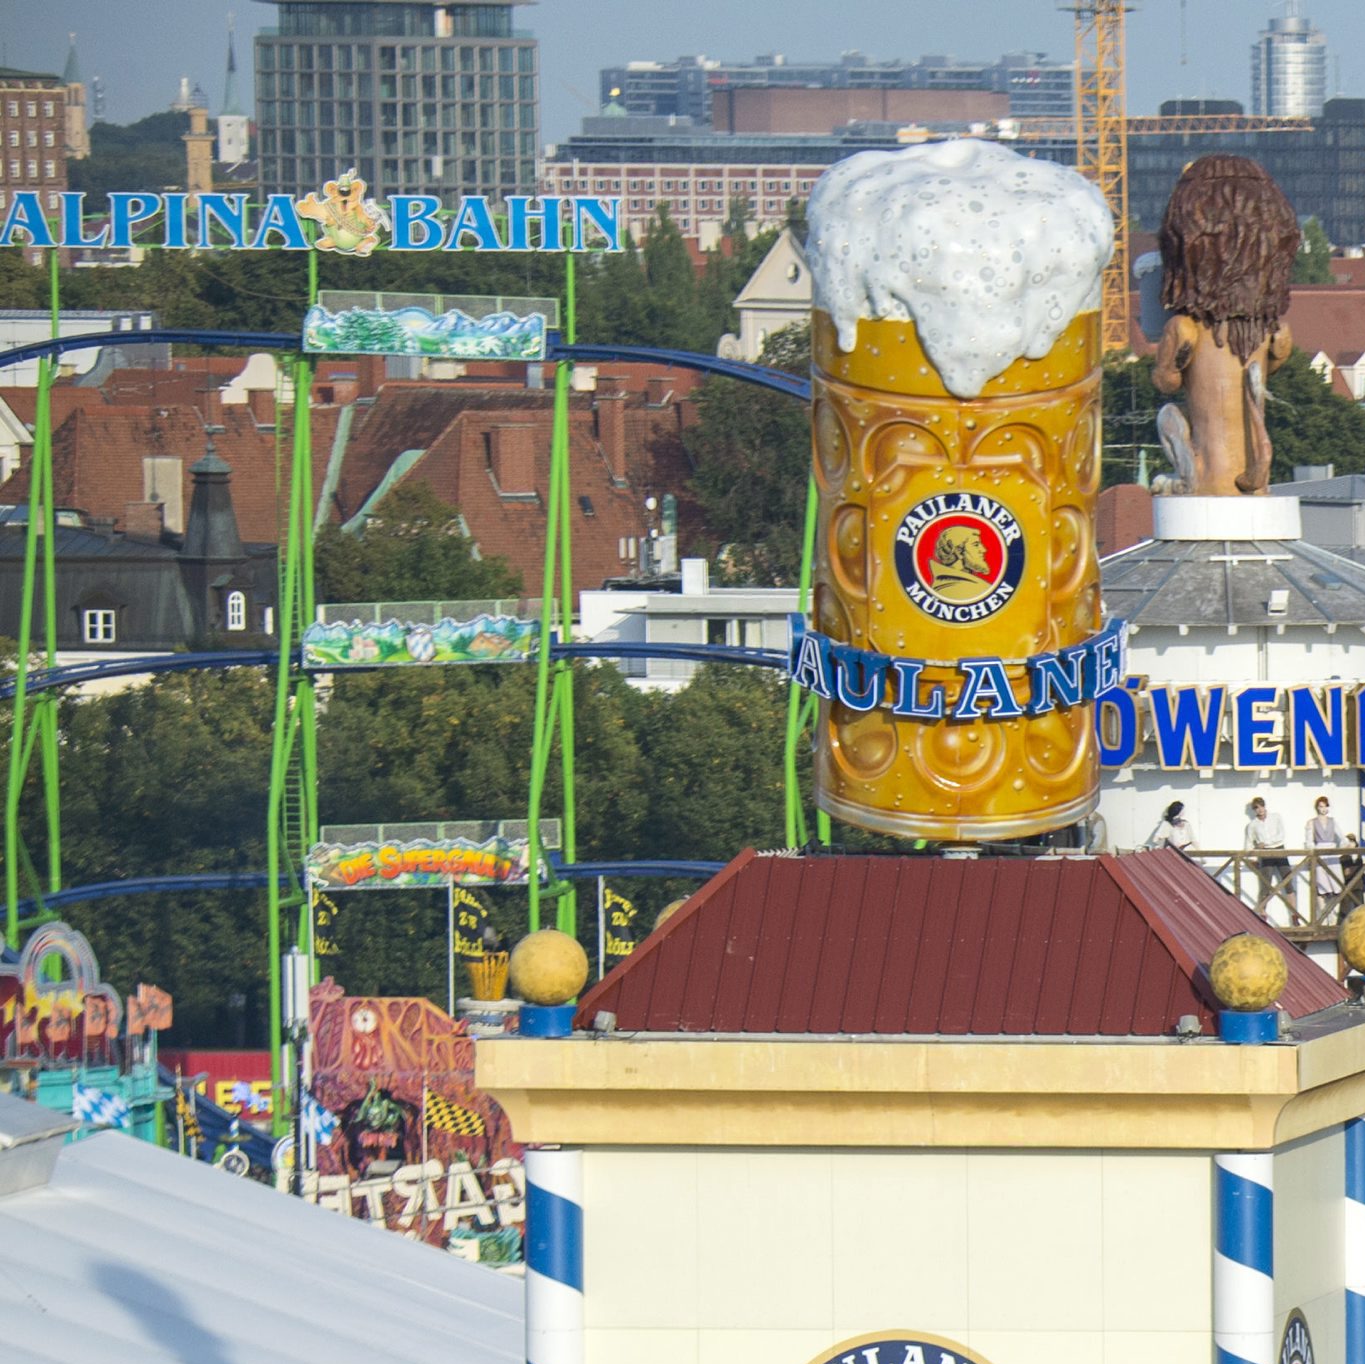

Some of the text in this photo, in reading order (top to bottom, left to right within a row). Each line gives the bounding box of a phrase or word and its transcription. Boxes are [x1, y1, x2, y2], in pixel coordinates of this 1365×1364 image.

[0, 192, 626, 252] ALPINA BAHN
[896, 493, 1023, 546] PAULANER
[905, 581, 1015, 621] MÜNCHEN
[787, 612, 1128, 719] AULANE
[338, 853, 375, 884] DIE
